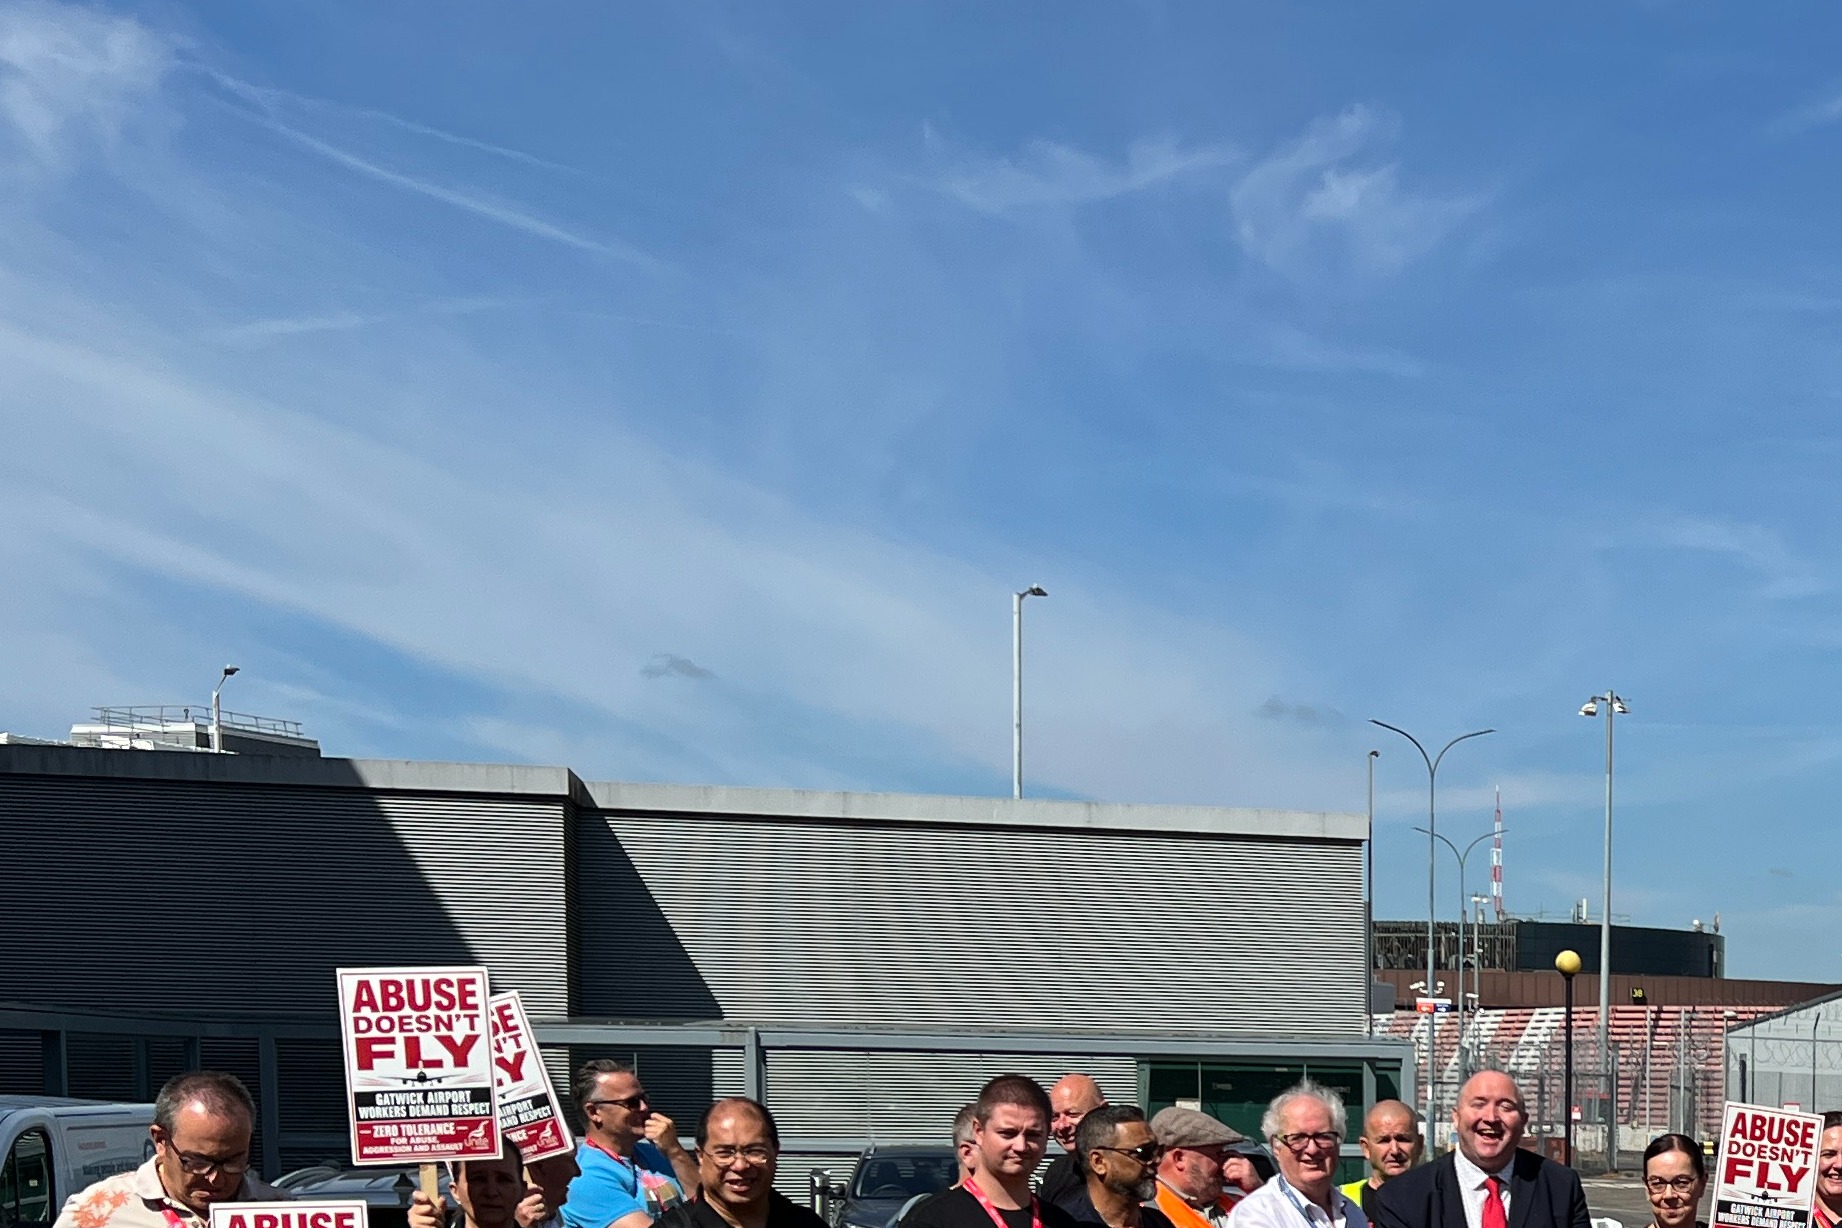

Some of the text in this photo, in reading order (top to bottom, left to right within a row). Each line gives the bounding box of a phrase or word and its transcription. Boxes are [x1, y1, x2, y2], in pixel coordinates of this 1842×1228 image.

[353, 978, 479, 1013] ABUSE
[353, 1014, 479, 1034] DOESN'T
[356, 1035, 480, 1070] FLY
[376, 1091, 471, 1106] GATWICK AIRPORT
[359, 1103, 489, 1119] WORKERS DEMAND RESPECT
[373, 1123, 455, 1138] ZERO TOLERANCE
[1730, 1112, 1816, 1148] ABUSE
[464, 1138, 488, 1147] unite
[1728, 1141, 1812, 1164] DOESN'T
[1725, 1157, 1810, 1192] FLY
